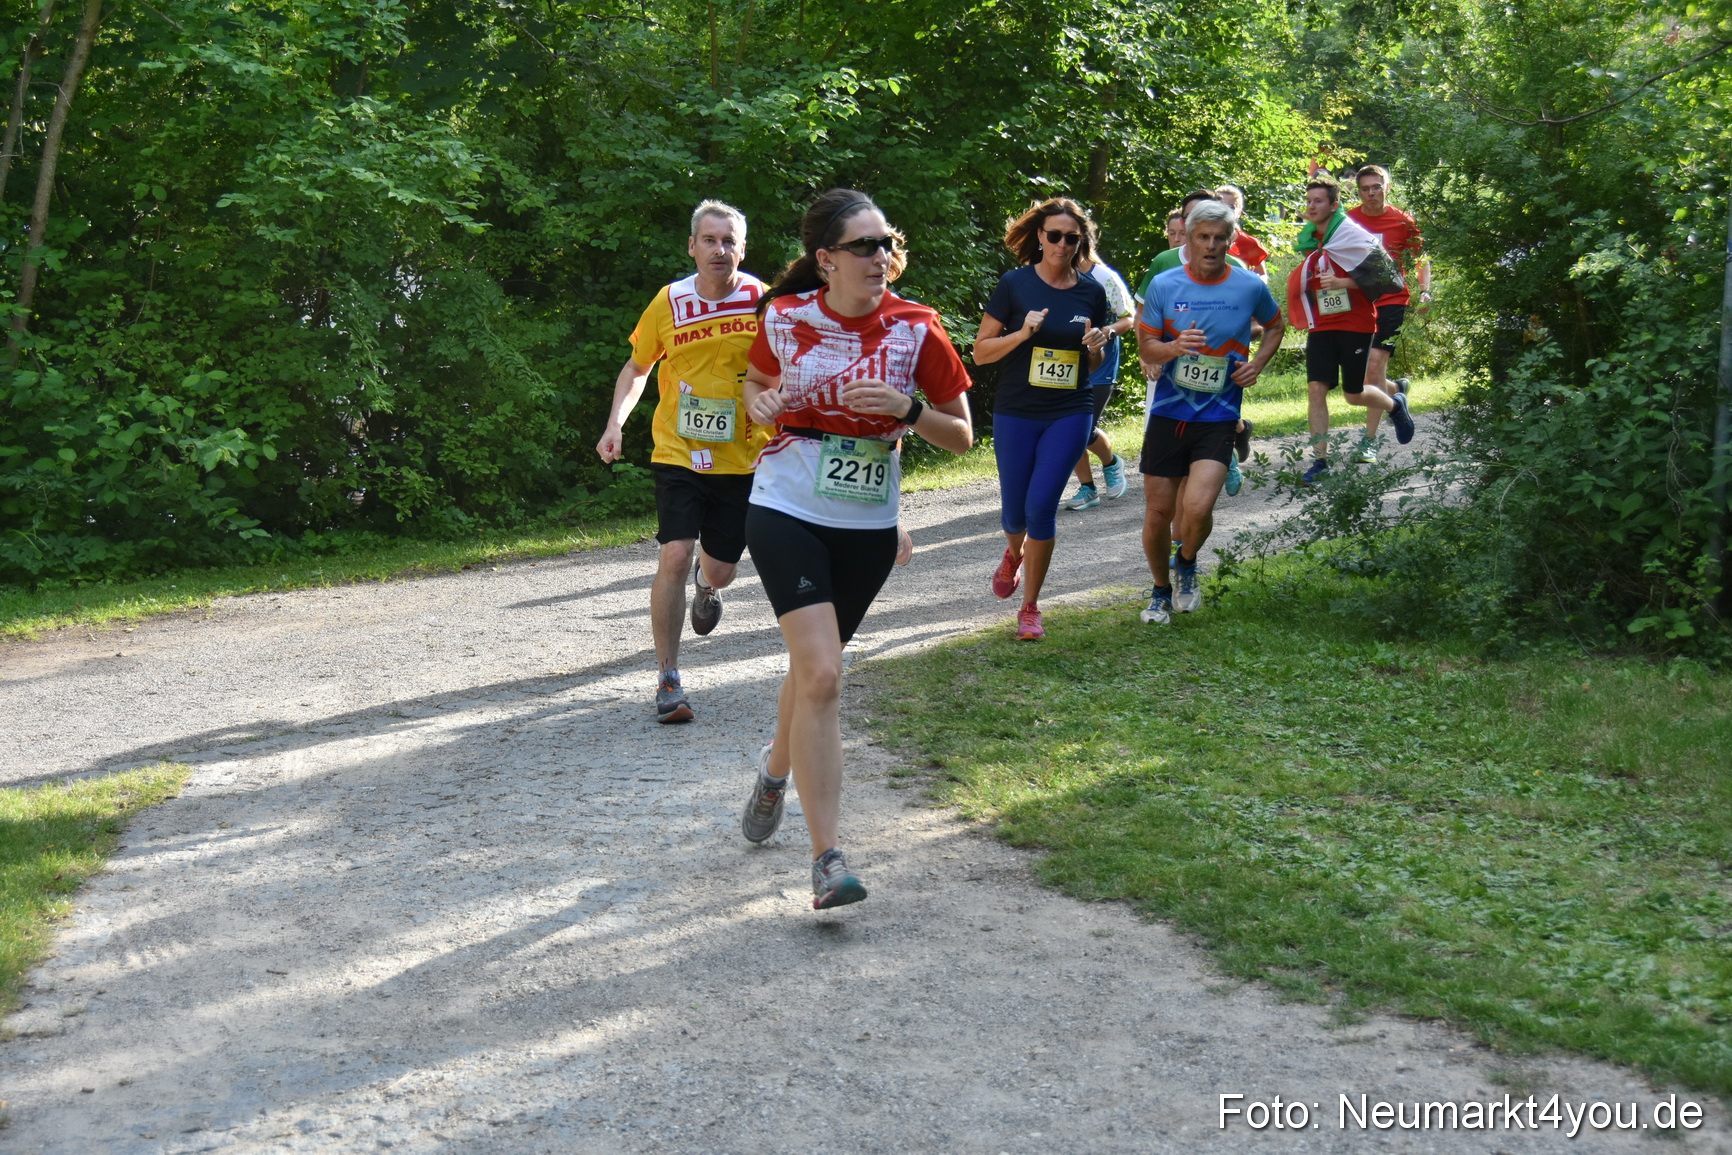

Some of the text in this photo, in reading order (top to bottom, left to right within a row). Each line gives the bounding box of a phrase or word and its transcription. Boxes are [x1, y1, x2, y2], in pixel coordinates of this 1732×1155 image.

[1323, 296, 1342, 308] 508
[674, 326, 714, 346] MAX
[1037, 361, 1074, 378] 1437
[1182, 364, 1219, 382] 1914
[684, 411, 727, 431] 1676
[827, 457, 885, 487] 2219
[833, 481, 860, 490] Mederer
